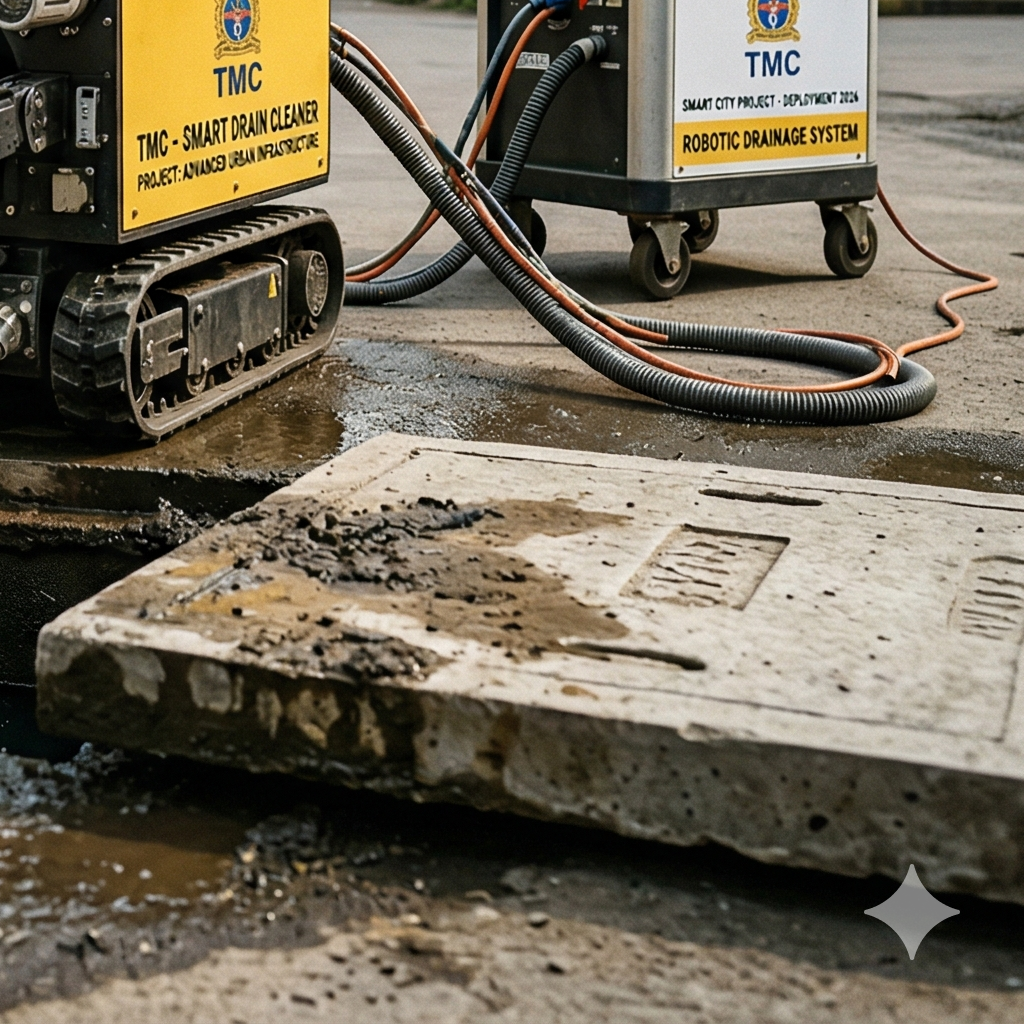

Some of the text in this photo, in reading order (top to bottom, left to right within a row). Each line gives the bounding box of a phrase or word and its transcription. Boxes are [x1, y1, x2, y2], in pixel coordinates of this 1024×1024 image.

[213, 61, 263, 98] TMC
[744, 49, 801, 78] TMC
[137, 129, 169, 162] TMC
[182, 117, 228, 152] SMART
[231, 109, 268, 142] DRAIN
[270, 99, 319, 133] CLEANER
[683, 123, 859, 154] ROBOTIC DRAINAGE SYSTEM
